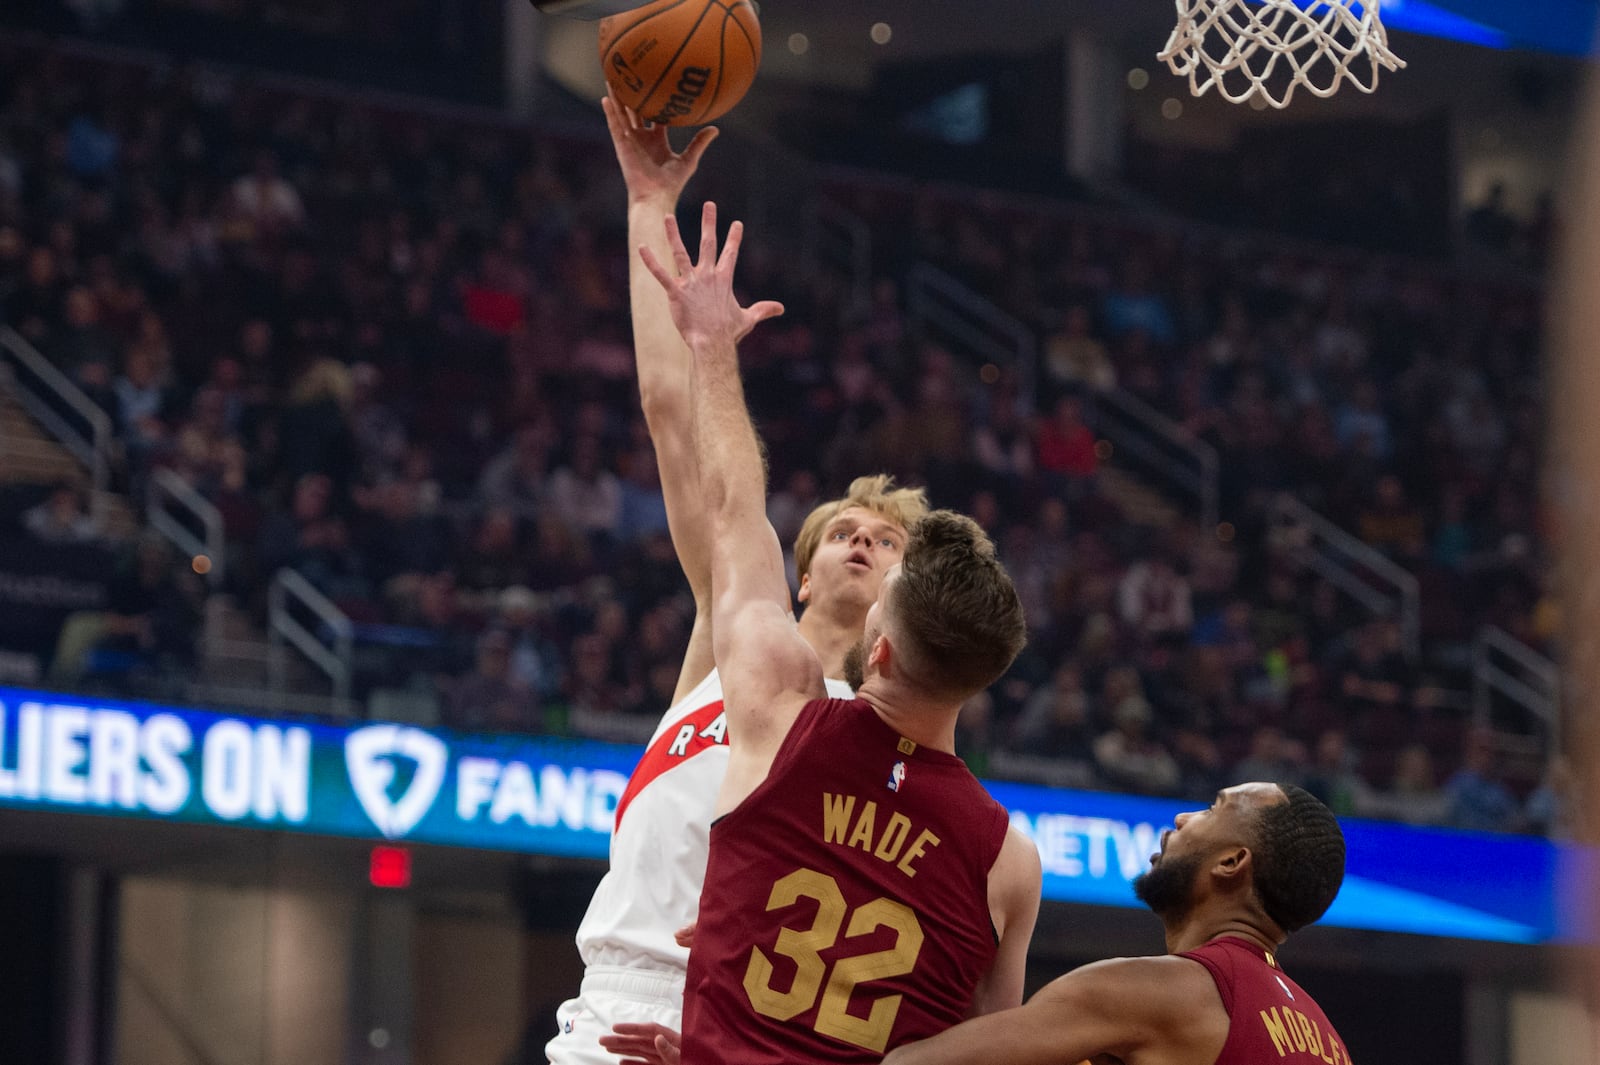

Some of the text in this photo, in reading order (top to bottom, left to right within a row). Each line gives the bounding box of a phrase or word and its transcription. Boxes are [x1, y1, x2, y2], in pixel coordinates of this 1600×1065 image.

[203, 718, 311, 822] ON
[457, 756, 628, 832] FAND
[823, 792, 941, 879] WADE
[742, 867, 925, 1054] 32
